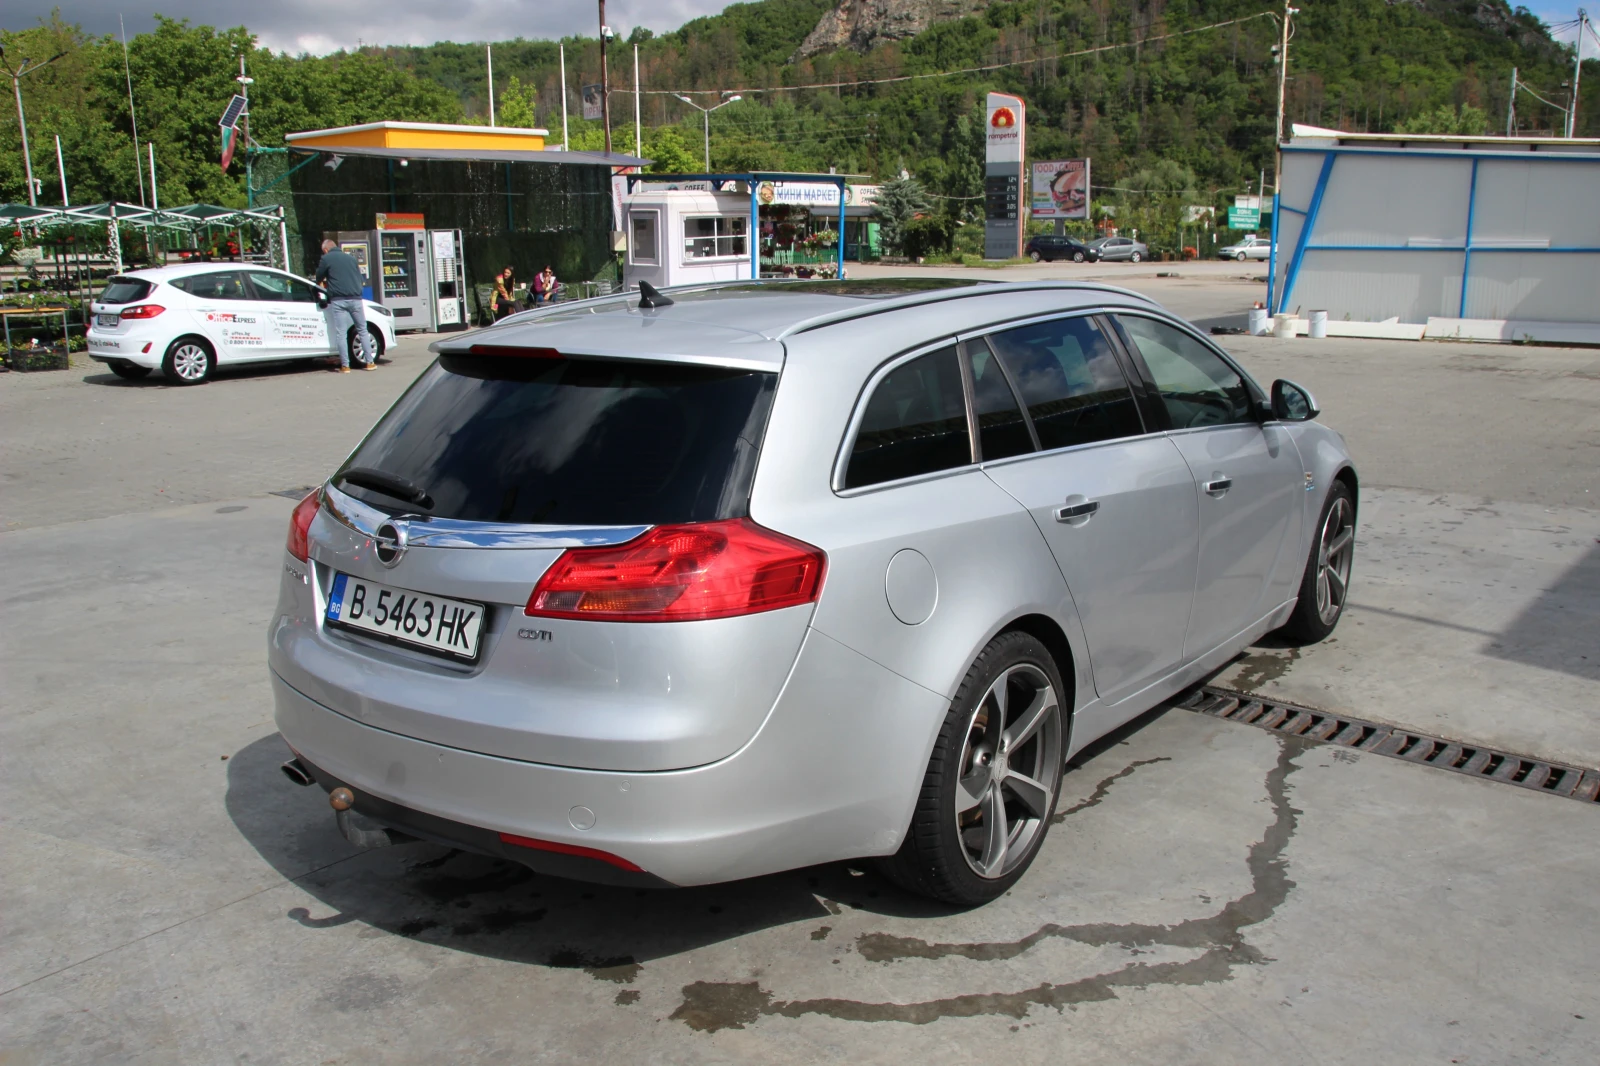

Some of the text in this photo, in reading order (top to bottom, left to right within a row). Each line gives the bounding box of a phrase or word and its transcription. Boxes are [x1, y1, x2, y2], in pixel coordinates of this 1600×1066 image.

[988, 132, 1018, 140] rompetrol
[1034, 164, 1054, 173] FOOD
[776, 188, 836, 201] МИНИ МАРКЕТ
[330, 602, 341, 614] BG
[349, 584, 366, 620] B
[374, 590, 435, 638] 5463
